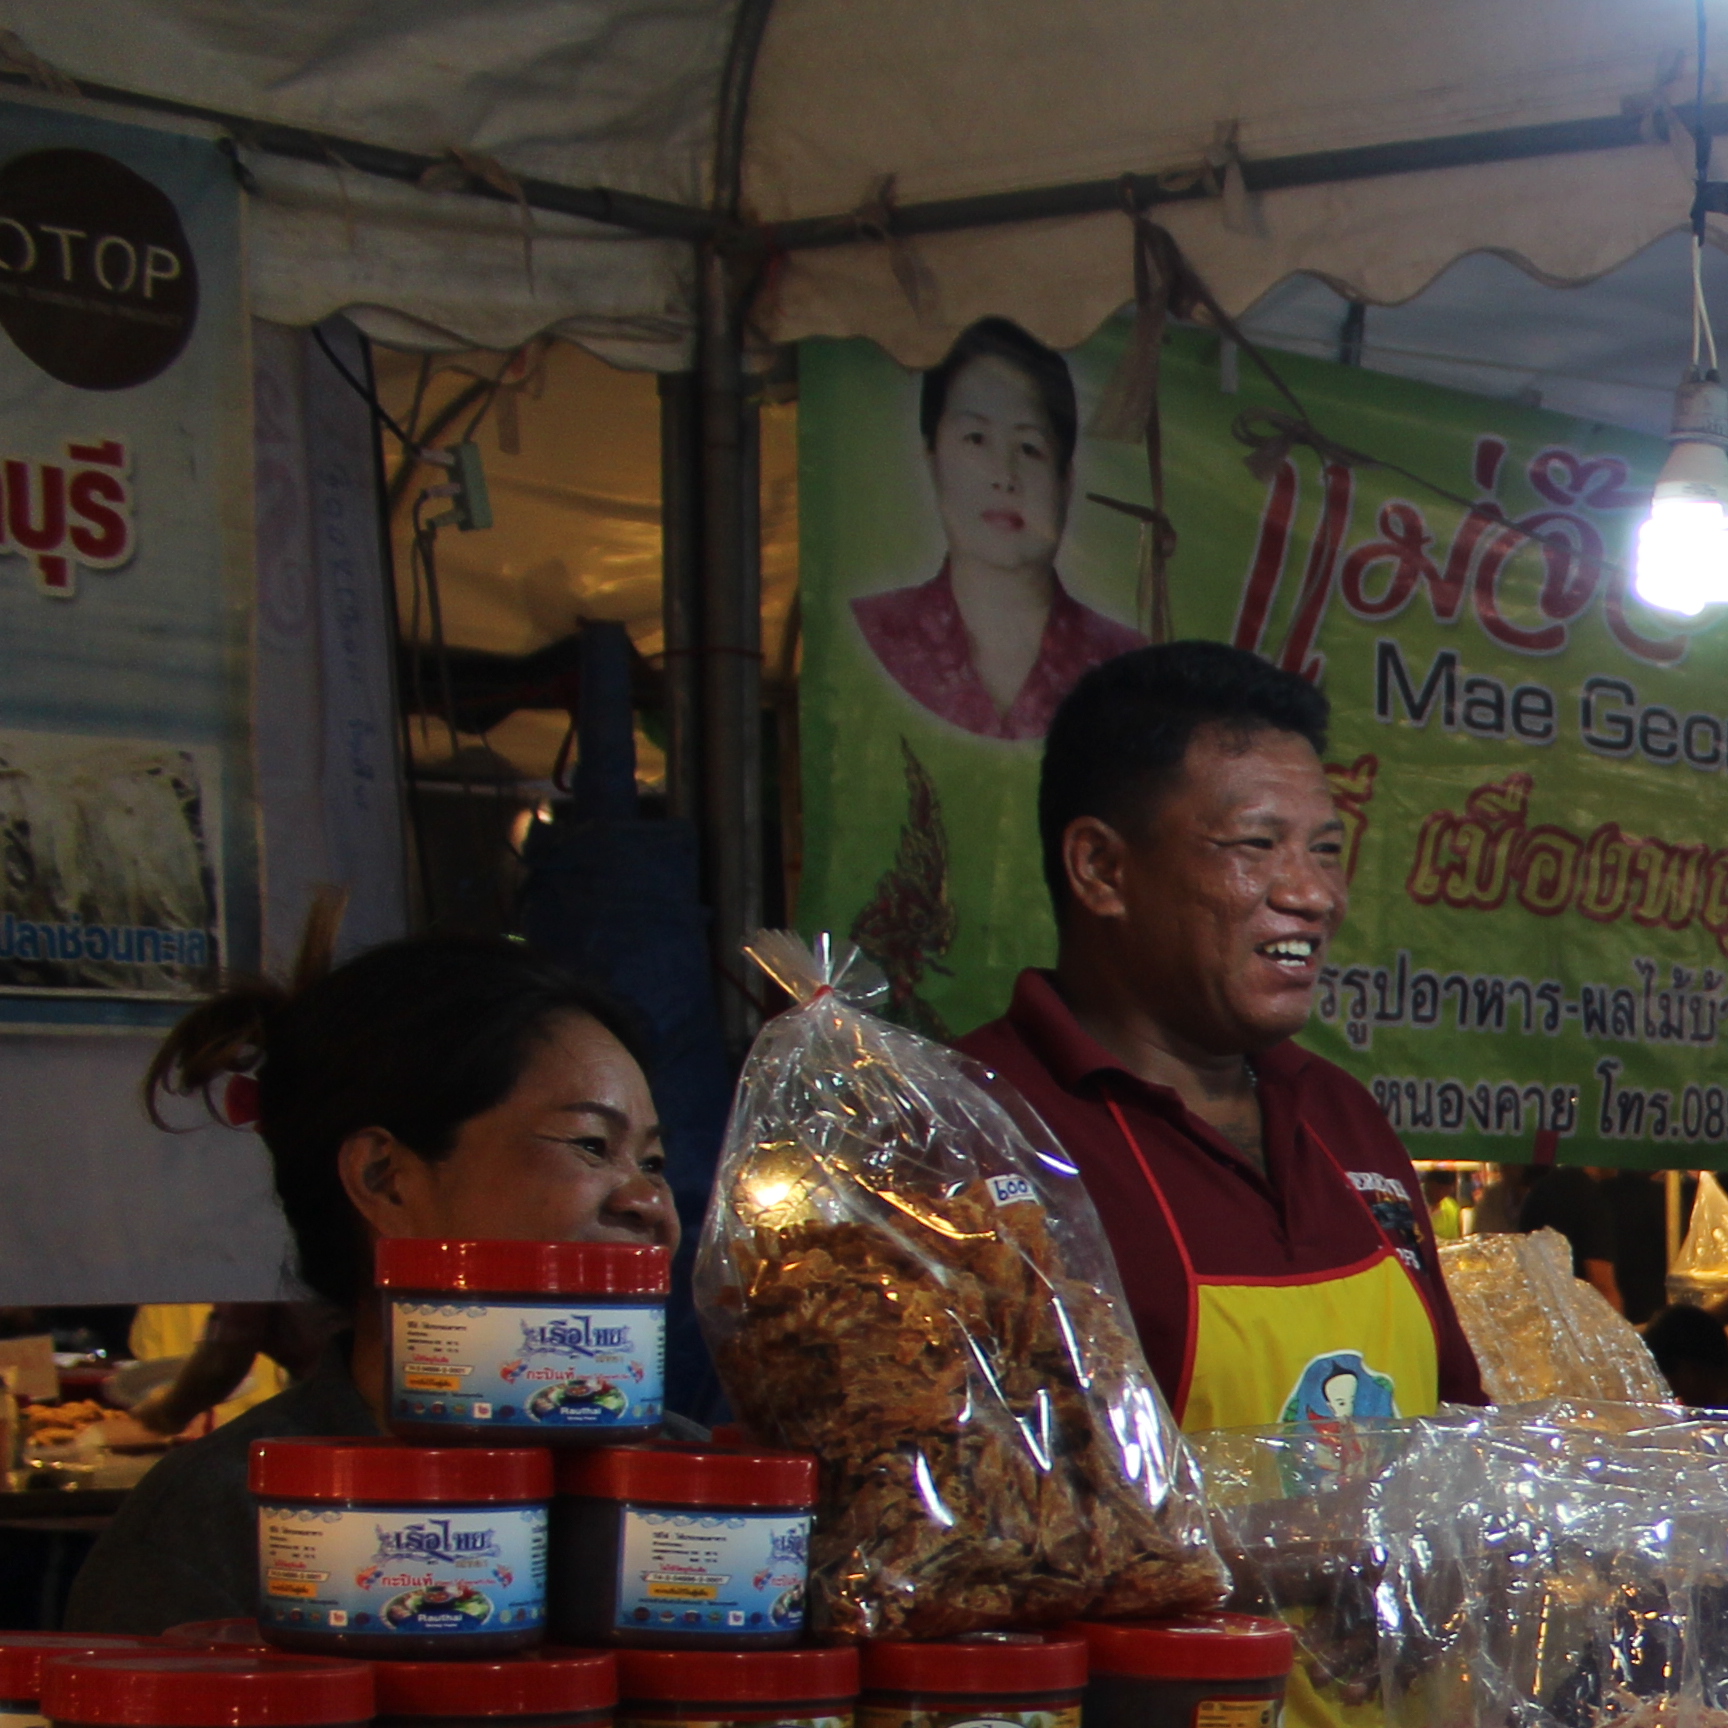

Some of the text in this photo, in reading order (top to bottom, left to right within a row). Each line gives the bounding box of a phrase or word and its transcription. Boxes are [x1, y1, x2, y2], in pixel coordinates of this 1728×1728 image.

[0, 215, 182, 299] OTOP
[0, 440, 128, 588] บุรี
[1375, 641, 1556, 741] Mae
